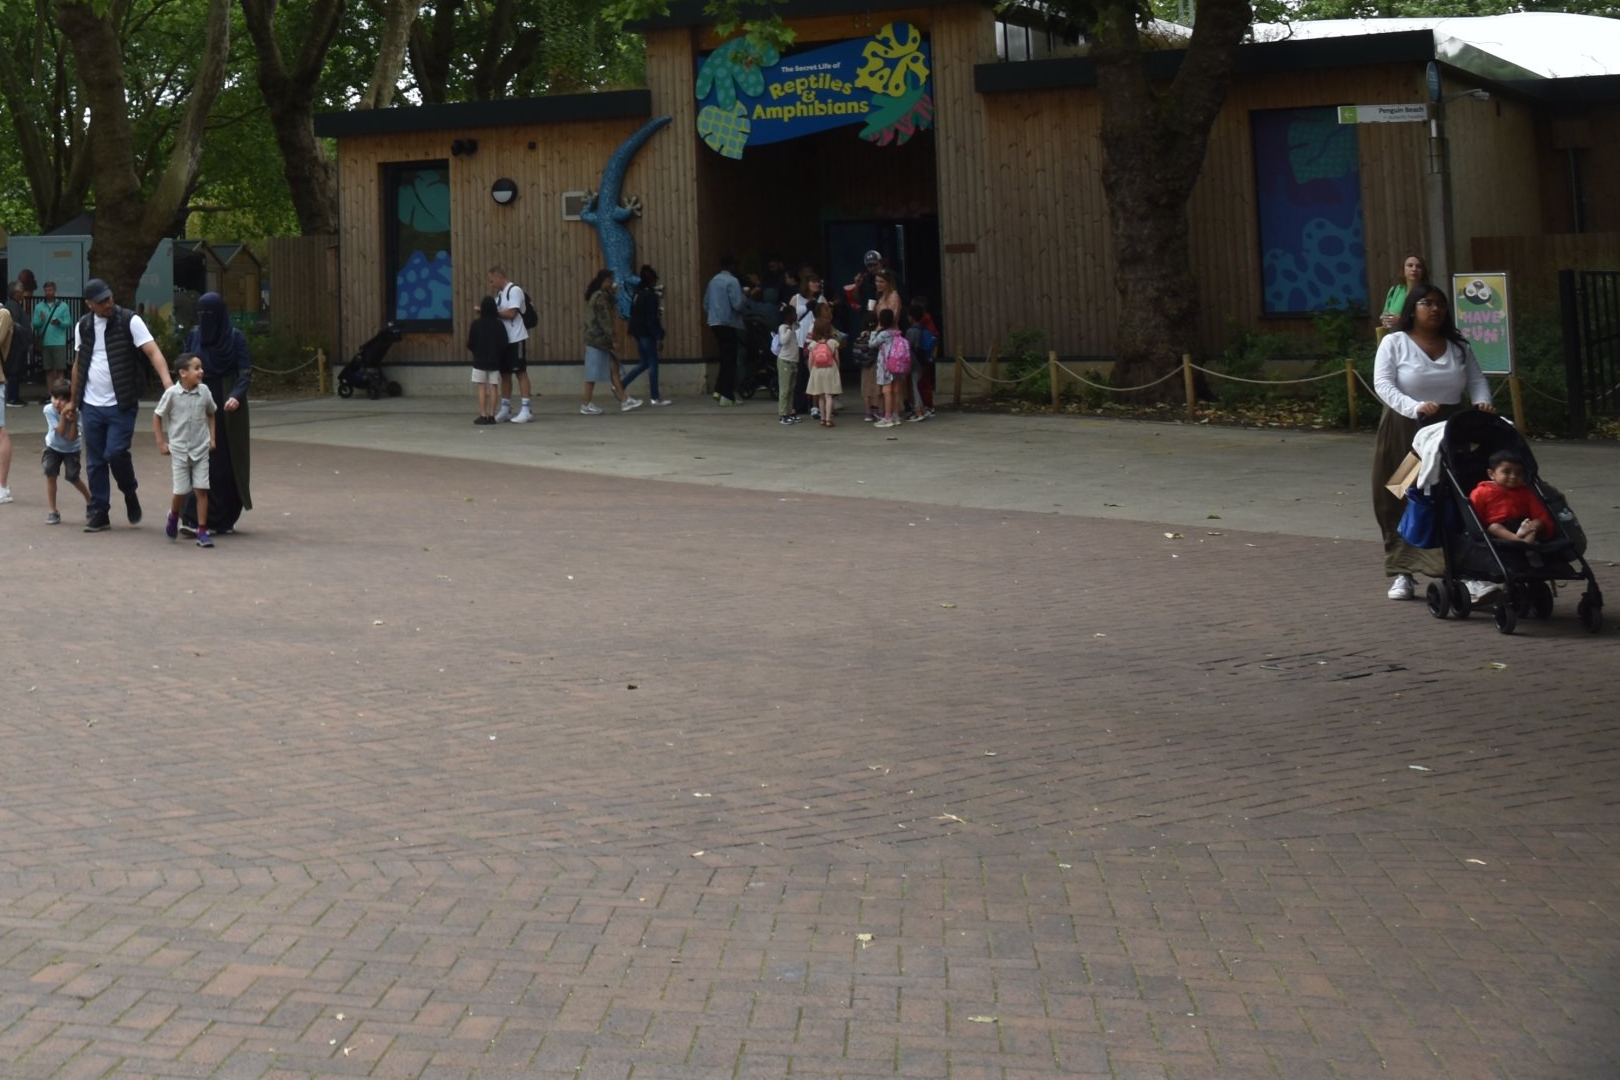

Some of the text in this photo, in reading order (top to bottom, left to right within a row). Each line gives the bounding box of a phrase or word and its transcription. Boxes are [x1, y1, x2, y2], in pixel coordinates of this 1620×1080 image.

[769, 73, 852, 99] Reptiles
[802, 90, 816, 103] &
[752, 99, 869, 122] Amphibians
[1378, 106, 1404, 114] Penguin
[1463, 311, 1500, 324] HAVE
